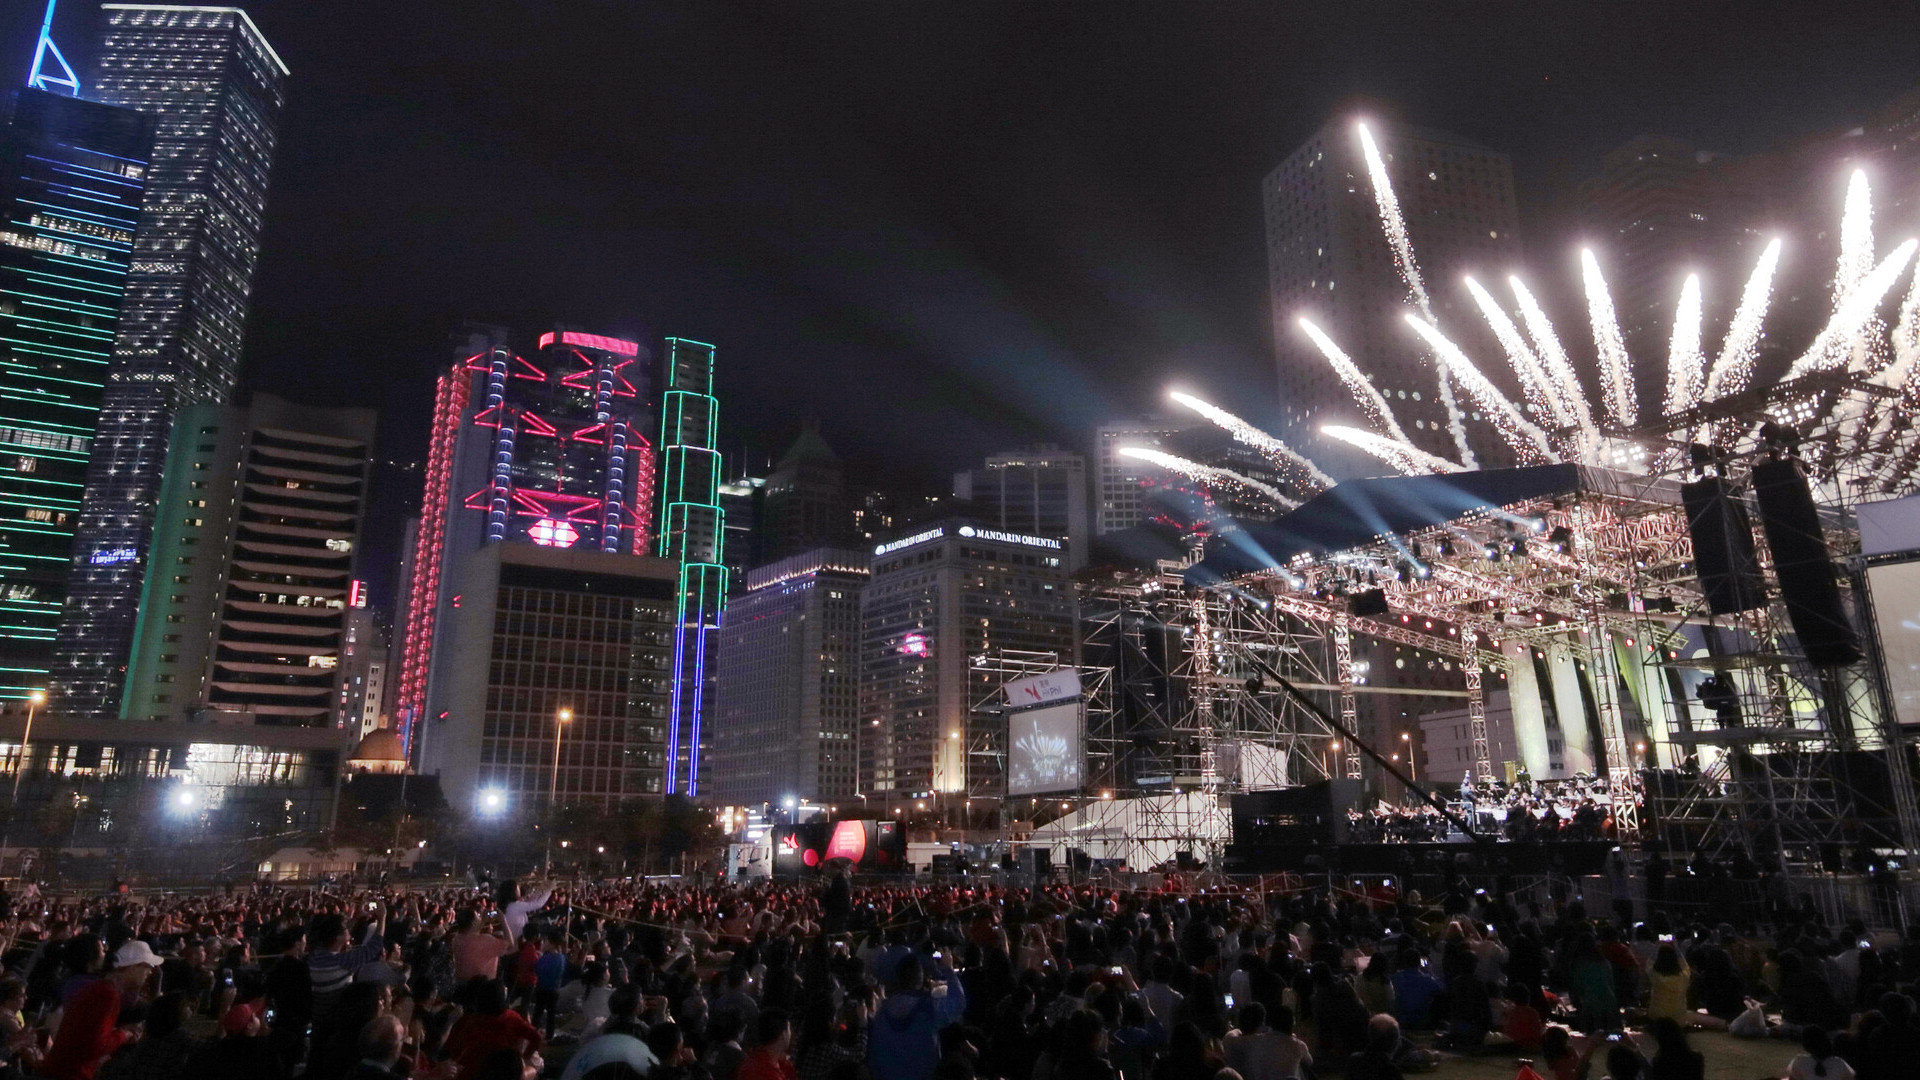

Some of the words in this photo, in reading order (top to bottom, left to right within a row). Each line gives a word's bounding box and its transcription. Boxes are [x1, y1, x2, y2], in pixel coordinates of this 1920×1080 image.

[886, 536, 915, 552] MANDARIN
[915, 527, 944, 544] ORIENTAL
[976, 529, 1021, 543] MANDARIN
[1021, 535, 1062, 549] ORIENTAL
